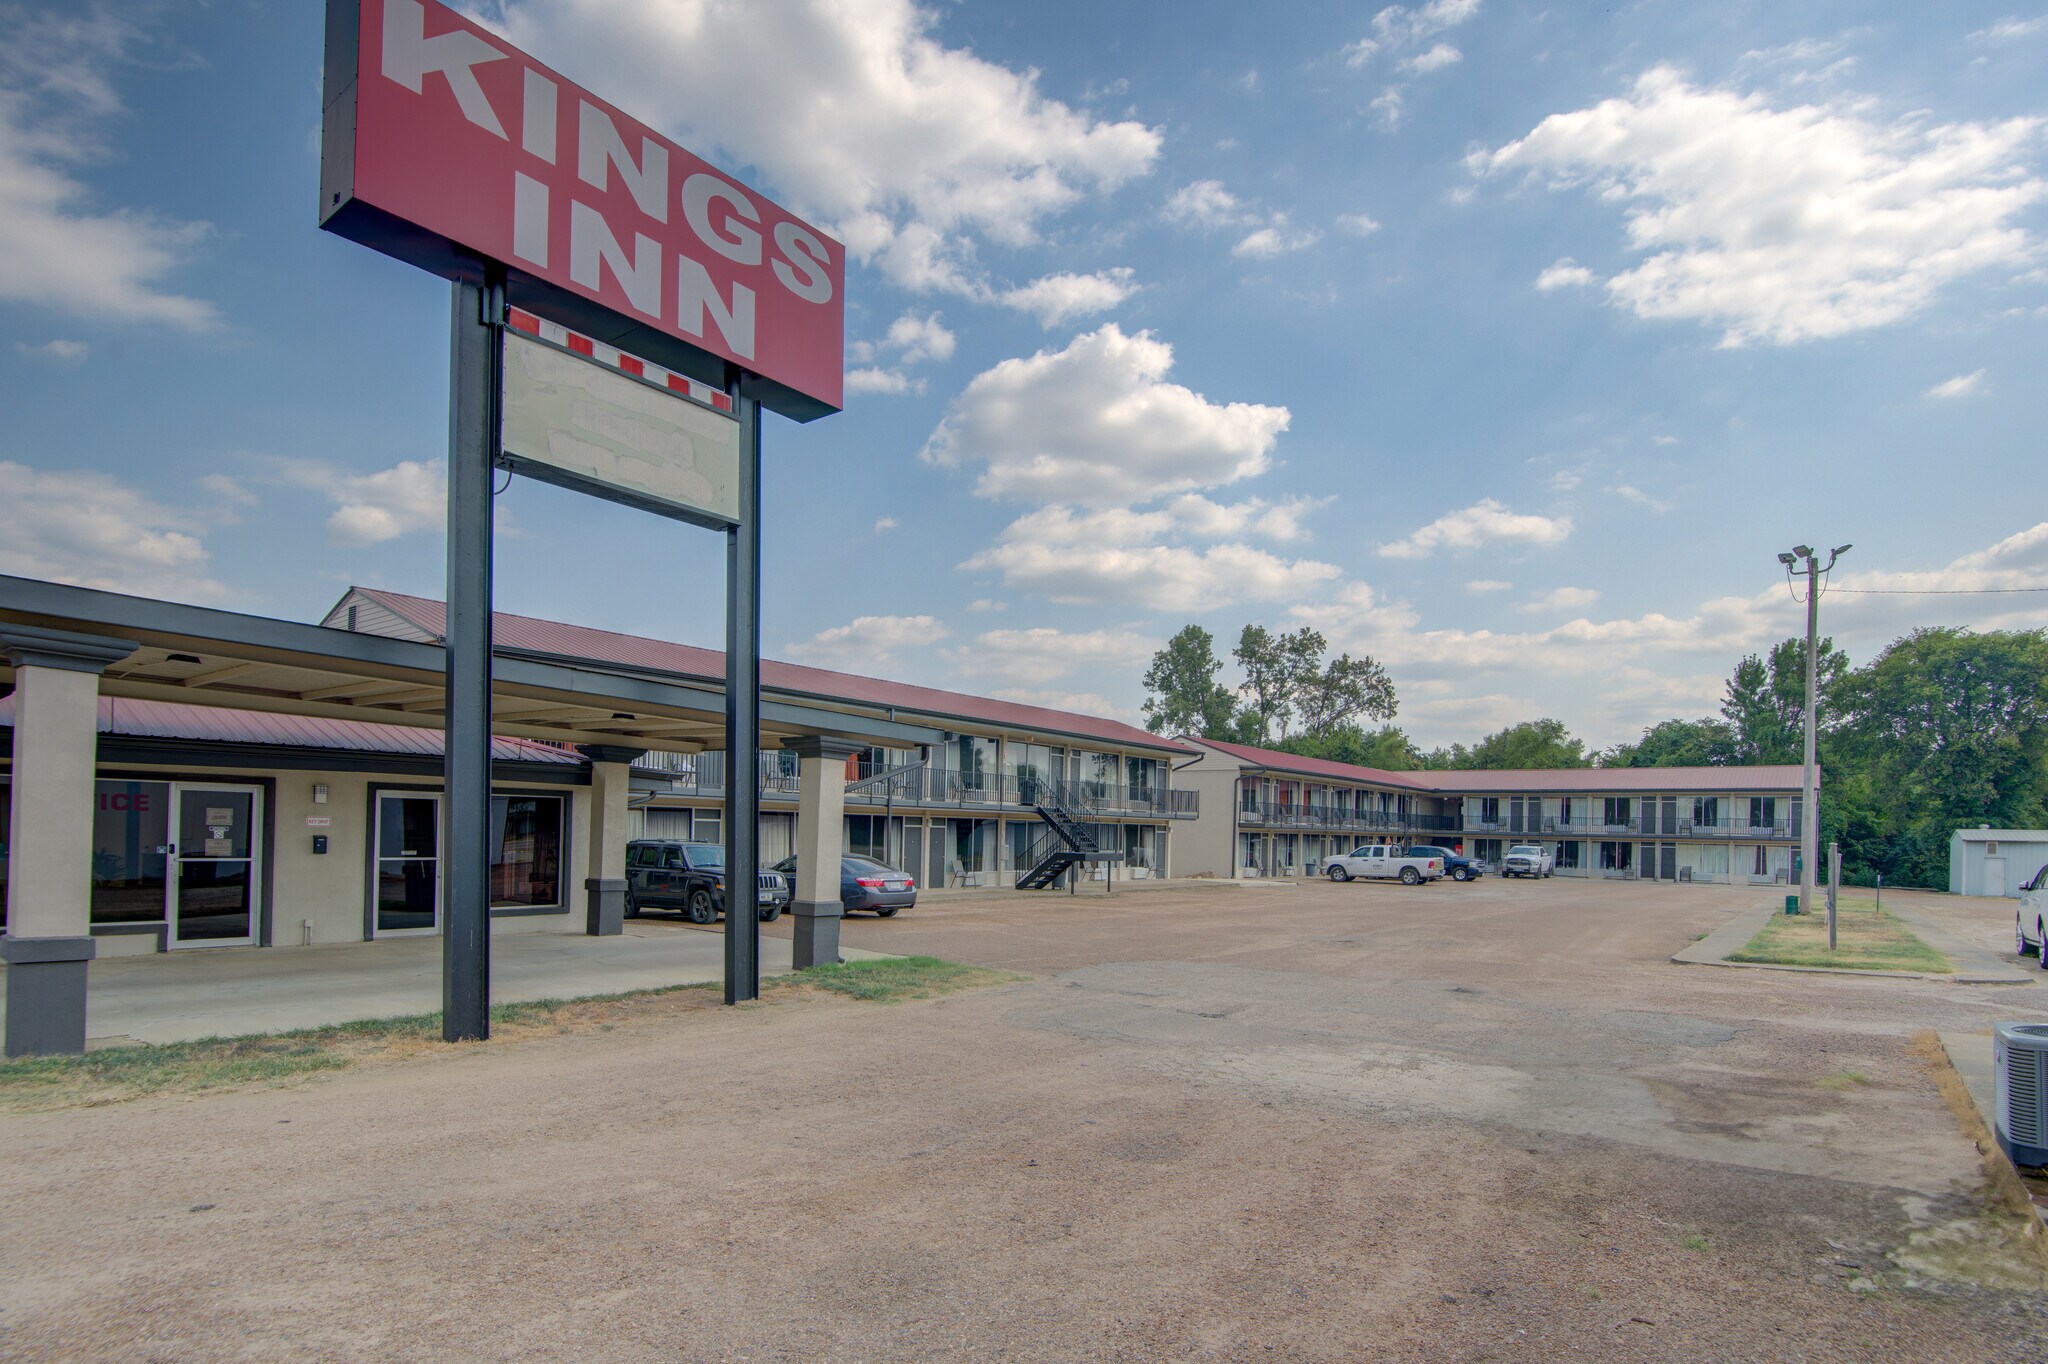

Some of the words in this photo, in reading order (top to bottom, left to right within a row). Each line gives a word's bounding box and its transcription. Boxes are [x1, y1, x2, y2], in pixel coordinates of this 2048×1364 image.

[381, 0, 833, 304] KINGS
[513, 170, 755, 361] INN
[98, 793, 150, 811] ICE
